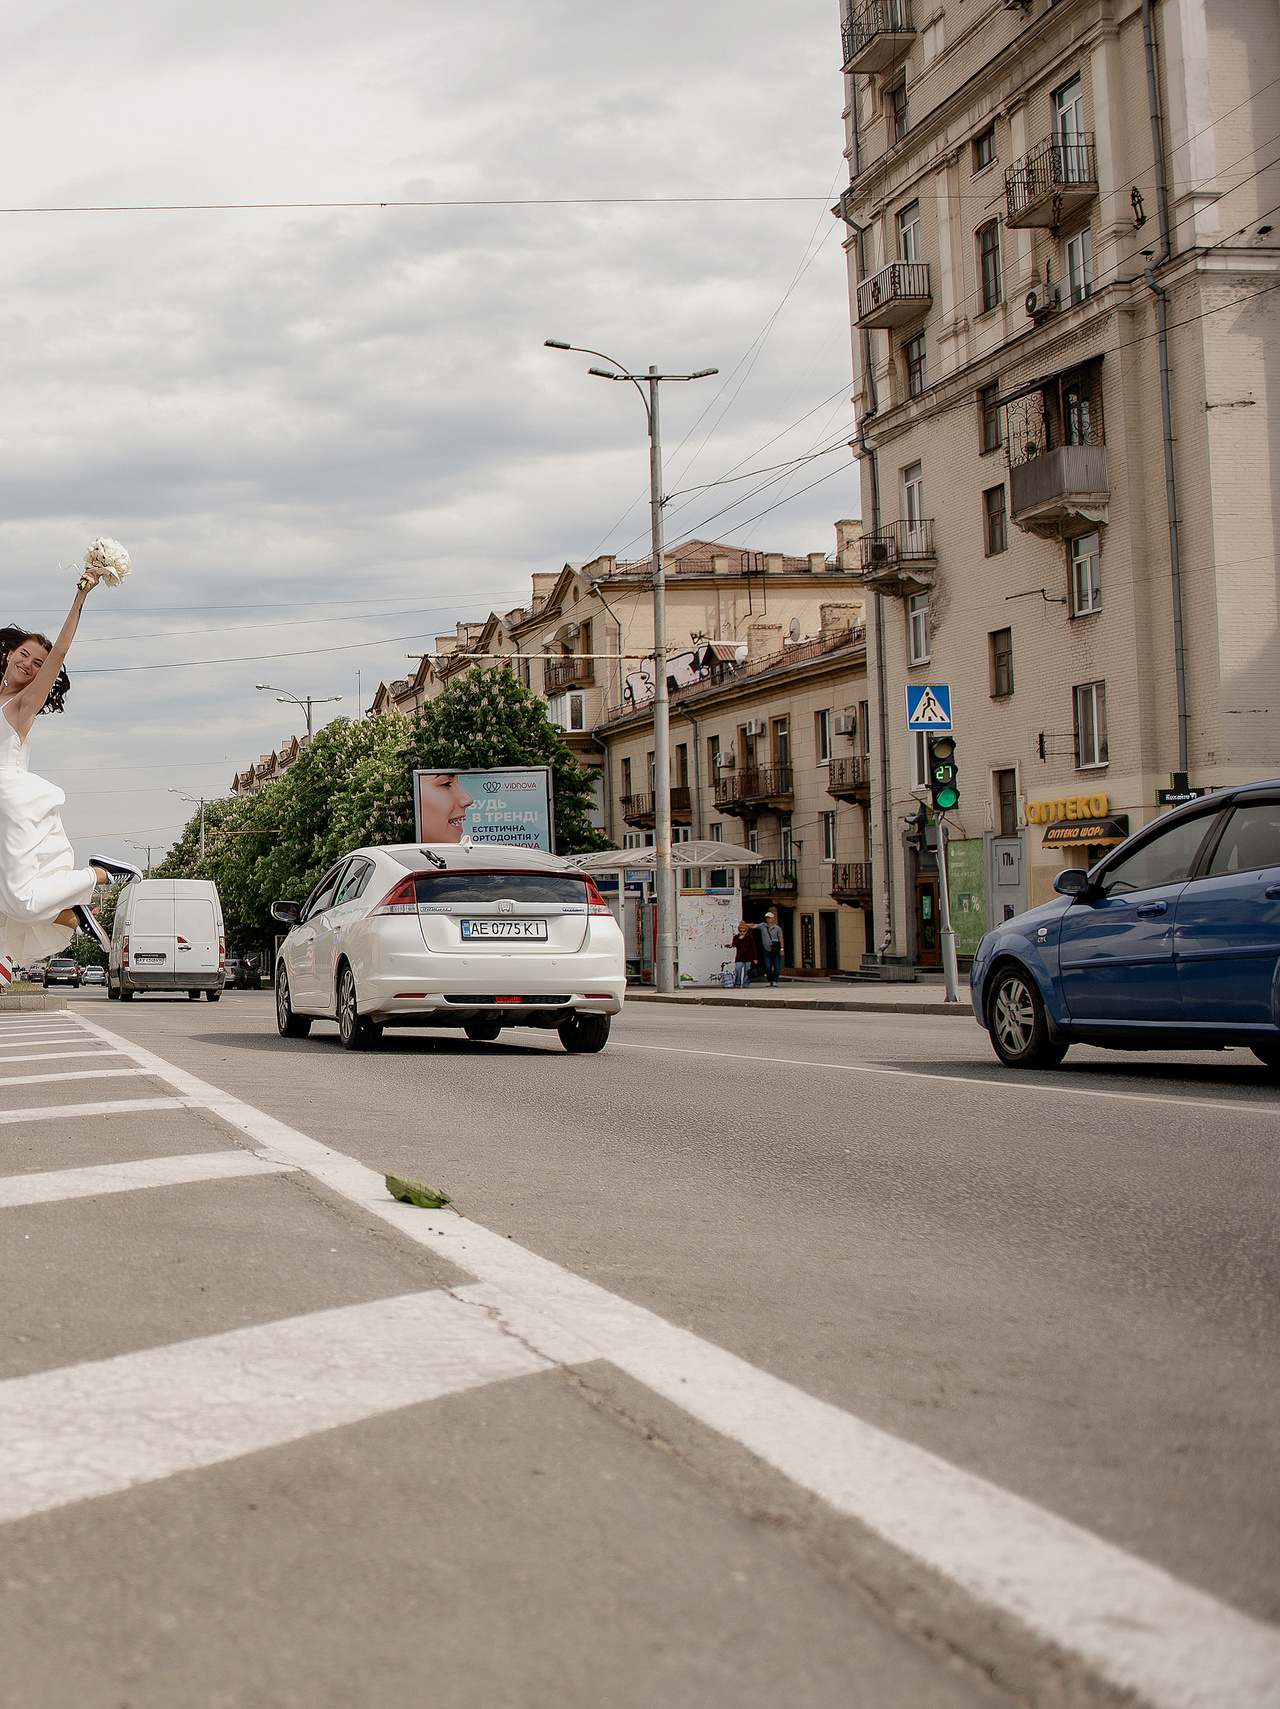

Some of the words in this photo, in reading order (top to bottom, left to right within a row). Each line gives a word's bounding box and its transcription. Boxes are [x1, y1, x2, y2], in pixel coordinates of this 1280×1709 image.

[936, 765, 952, 780] 27
[504, 781, 537, 790] VIDNOVA
[468, 799, 508, 811] БУДЬ
[472, 812, 482, 823] В
[485, 811, 539, 823] ТРЕНДІ
[472, 824, 526, 833] ЕСТЕТИЧНА
[472, 833, 531, 843] ОРТОДОНТІЯ
[534, 833, 540, 841] У
[471, 923, 488, 935] AE
[492, 922, 521, 935] 0775
